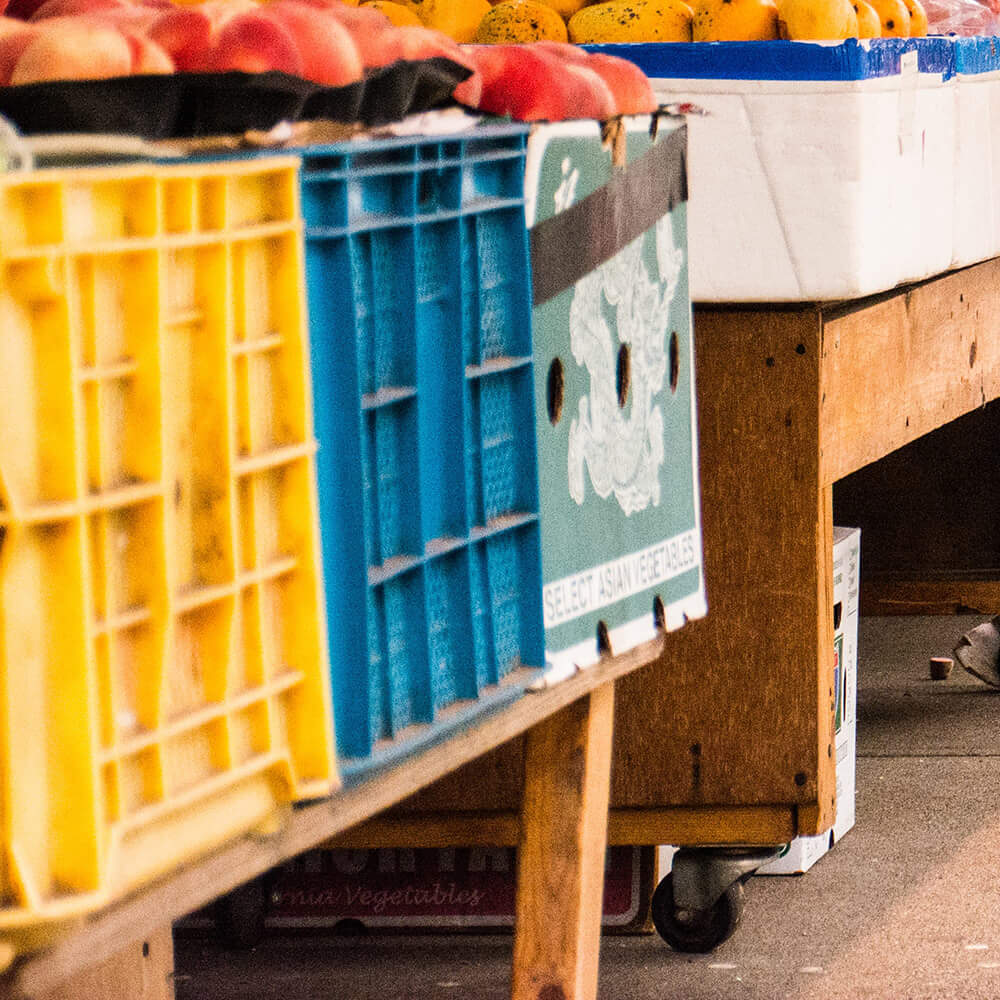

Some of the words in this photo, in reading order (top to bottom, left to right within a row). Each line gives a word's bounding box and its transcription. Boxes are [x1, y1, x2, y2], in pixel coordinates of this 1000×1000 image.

[544, 573, 592, 618] SELECT
[599, 564, 631, 599] ASIAN
[633, 535, 695, 585] VEGETABLES
[346, 884, 488, 913] Vegetables
